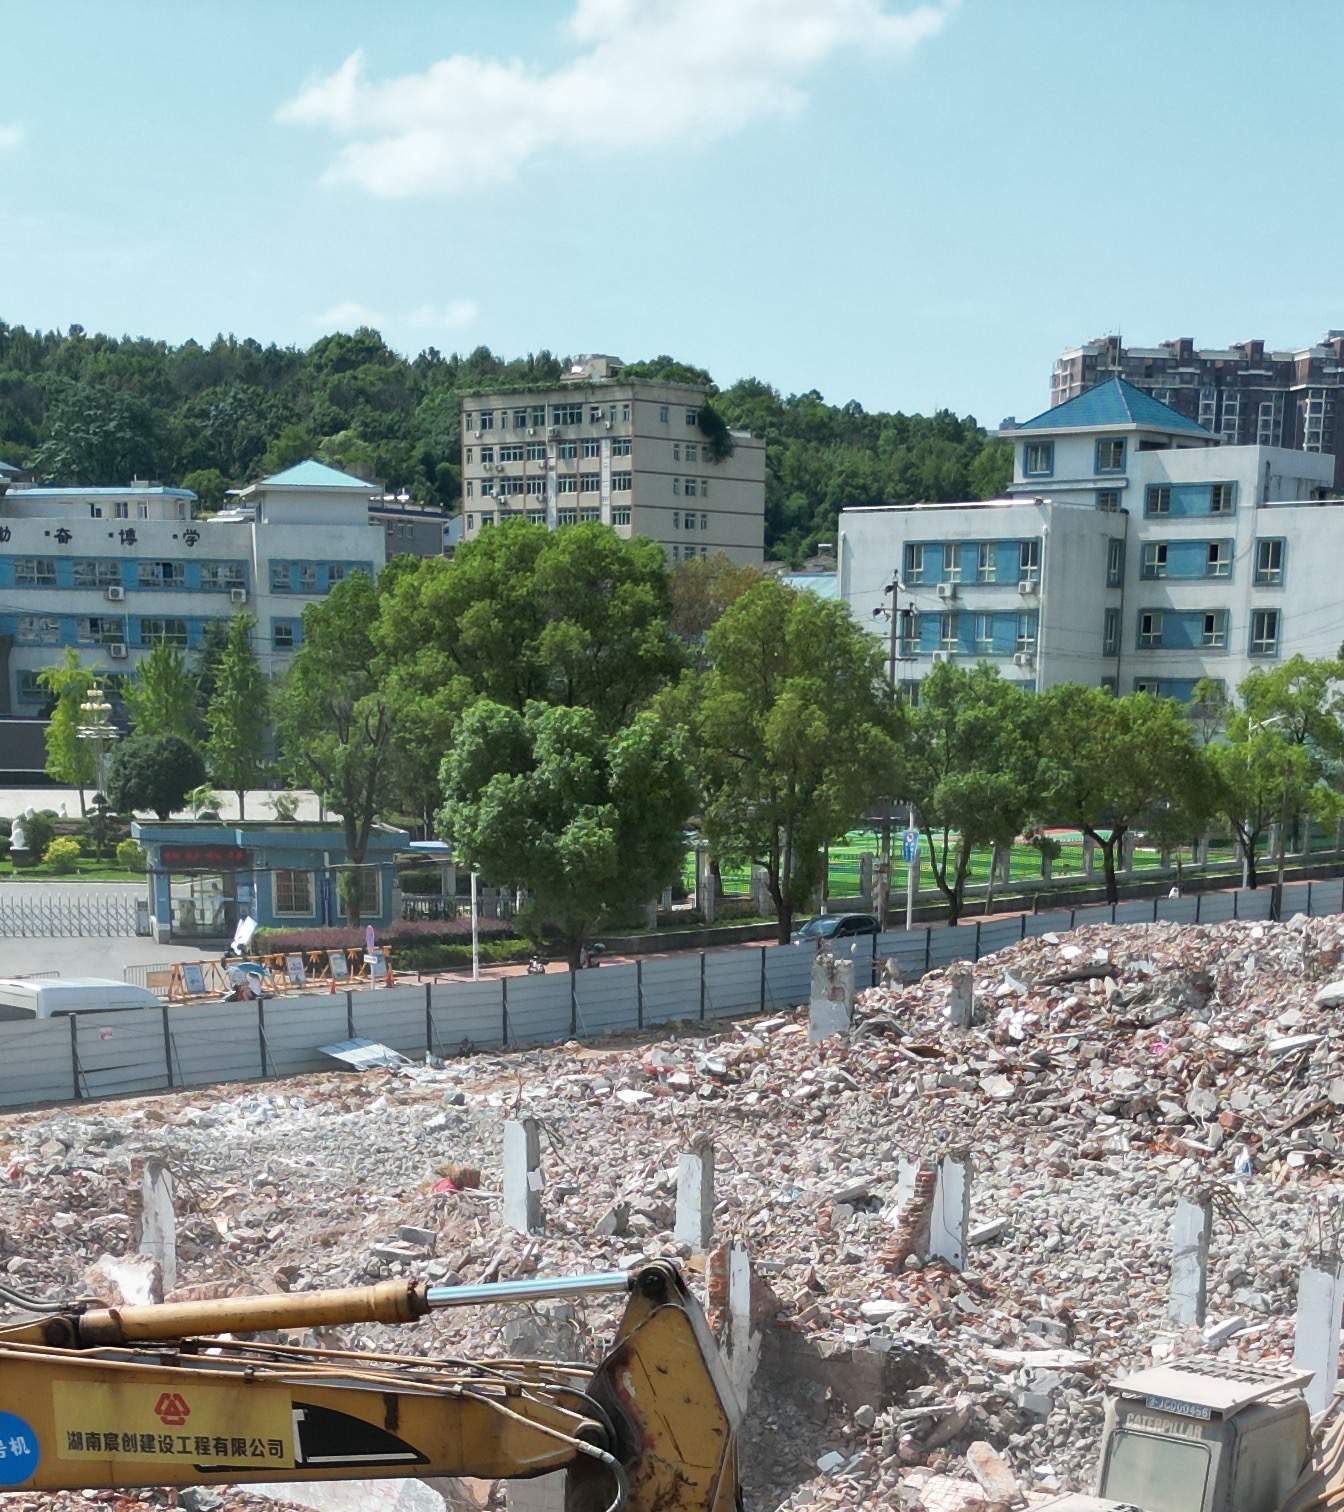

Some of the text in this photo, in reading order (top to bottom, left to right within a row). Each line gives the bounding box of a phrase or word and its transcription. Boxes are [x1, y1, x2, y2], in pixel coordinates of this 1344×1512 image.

[1126, 1412, 1203, 1440] CATERPILLAR
[67, 1431, 284, 1459] 湖南宸创建设工程有限公司
